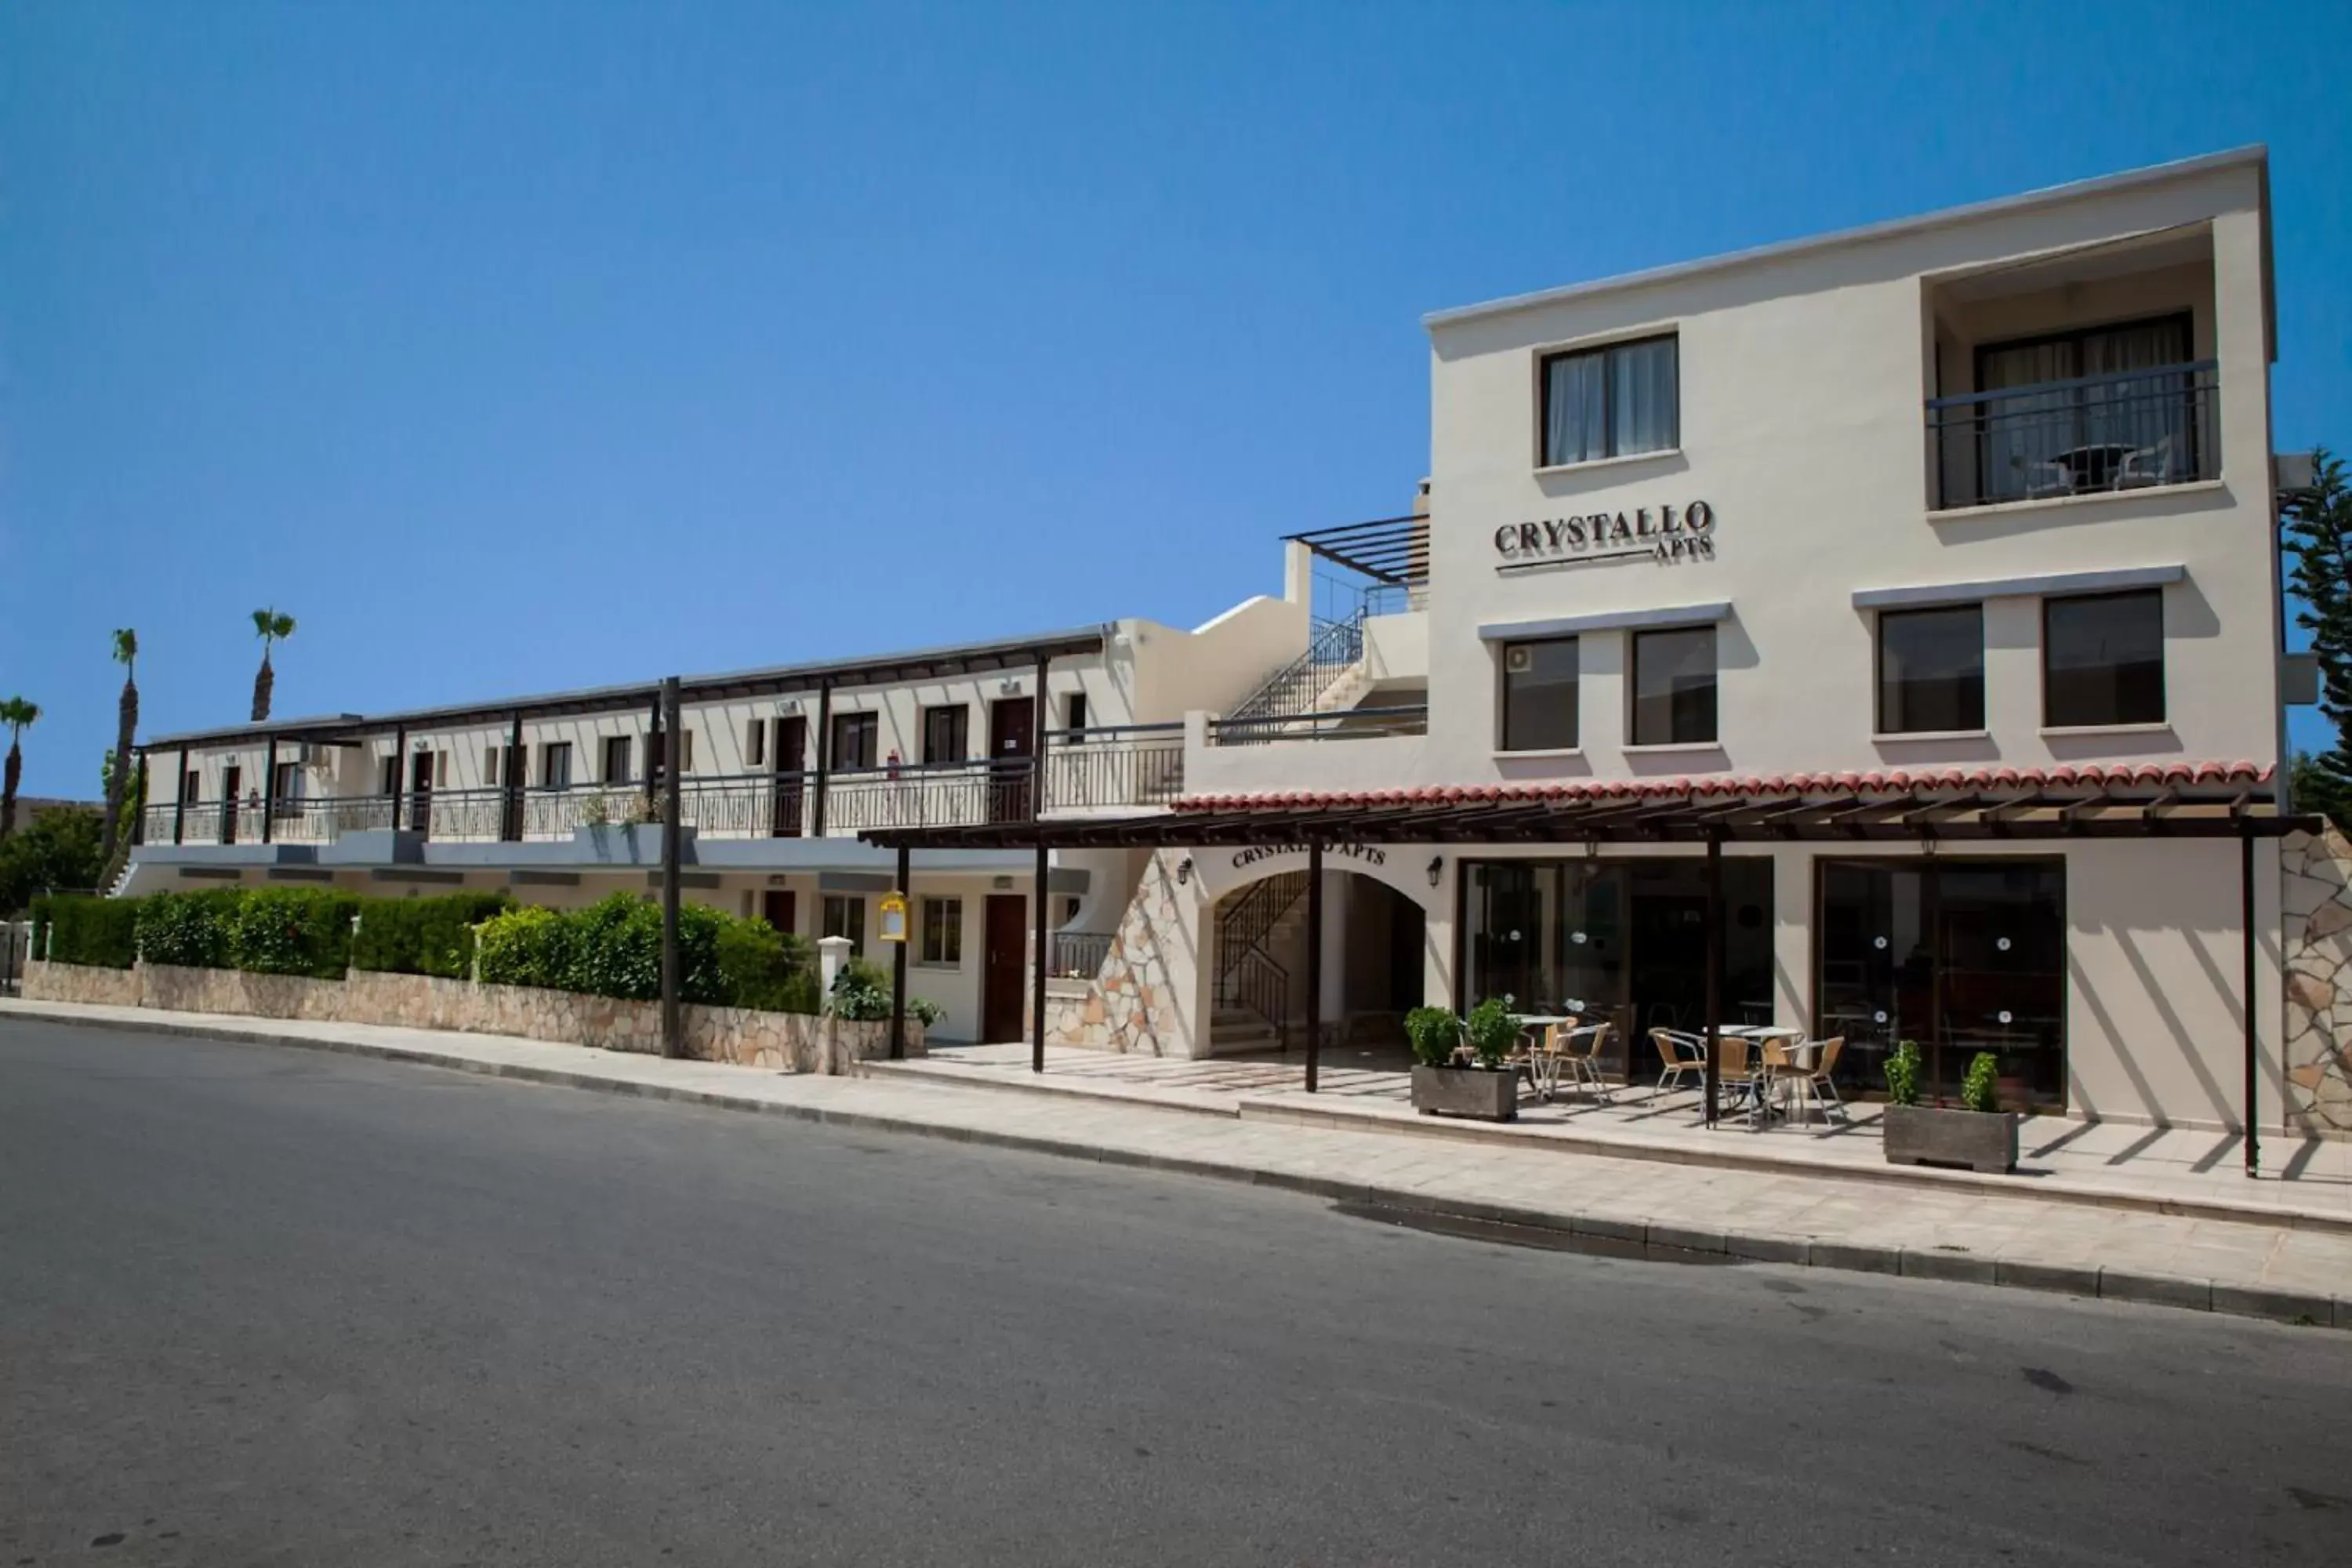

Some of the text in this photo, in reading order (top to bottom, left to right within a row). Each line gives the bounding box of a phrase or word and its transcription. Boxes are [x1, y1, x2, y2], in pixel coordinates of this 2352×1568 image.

[1494, 500, 1712, 553] CRYSTALLO
[1654, 535, 1712, 561] APTS
[1232, 843, 1385, 868] CRYSTALO APTS
